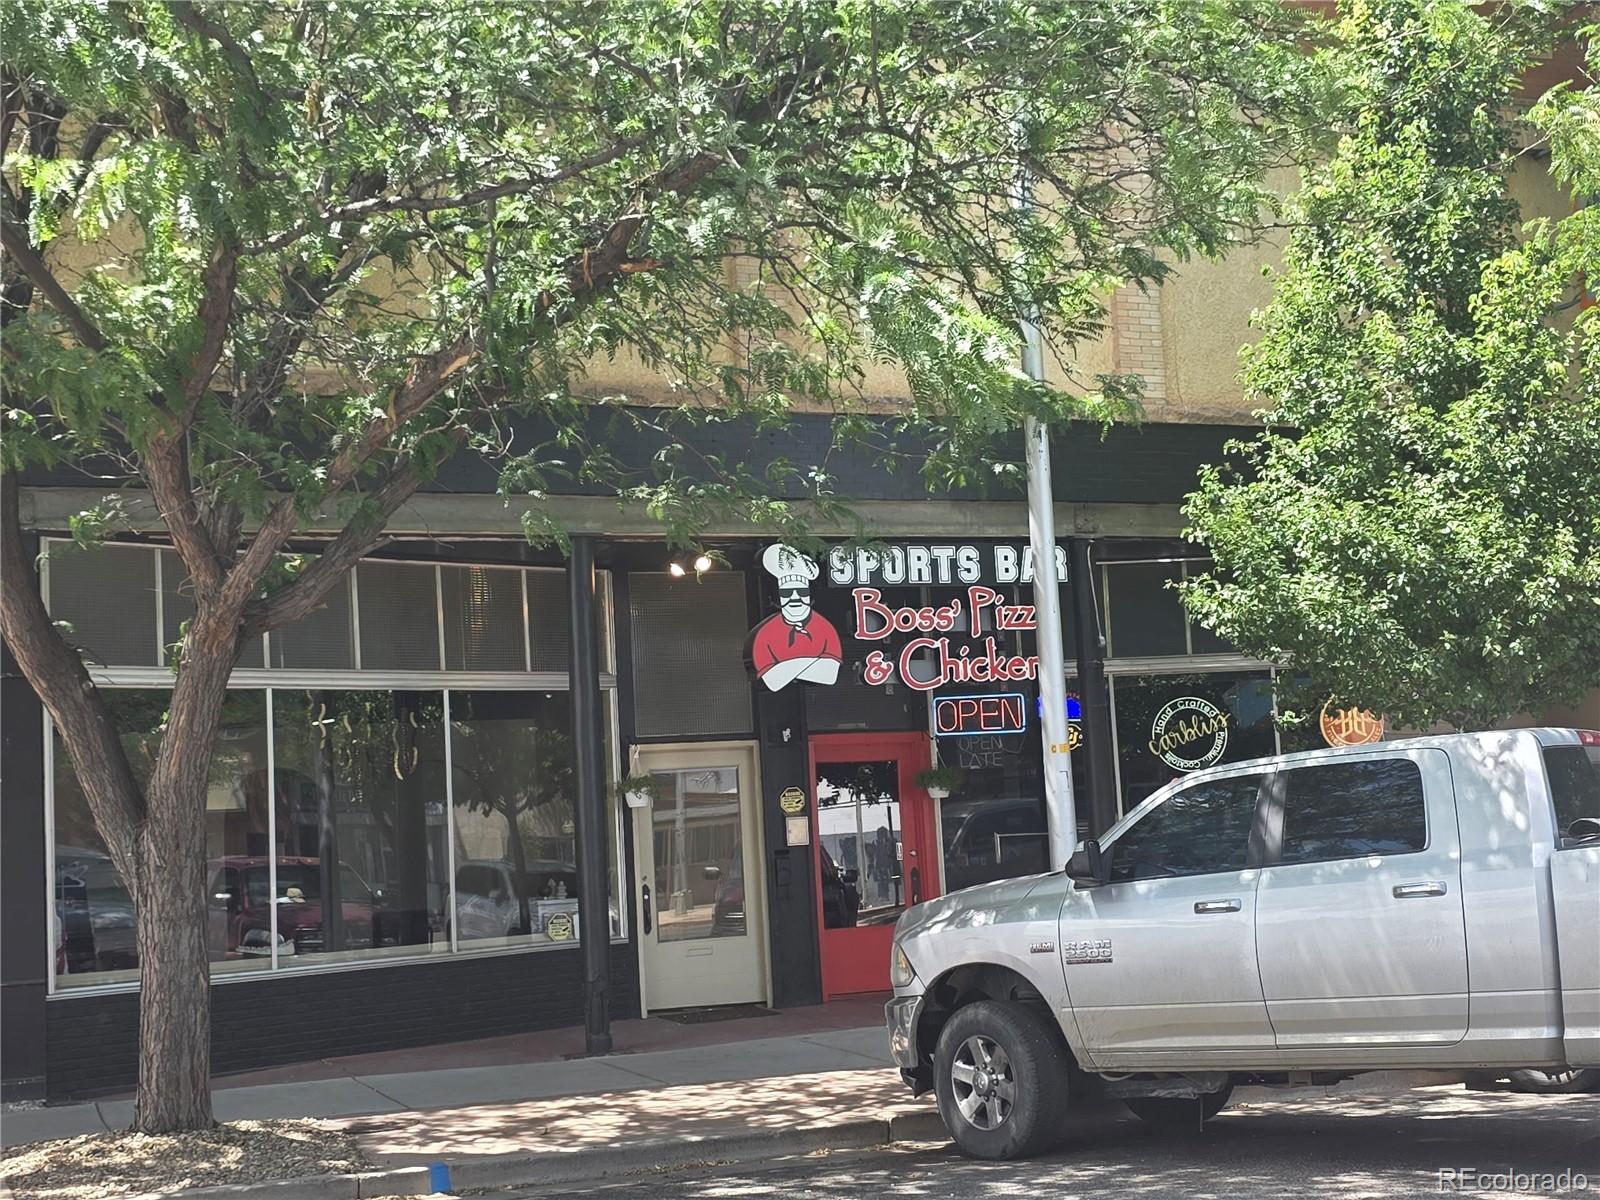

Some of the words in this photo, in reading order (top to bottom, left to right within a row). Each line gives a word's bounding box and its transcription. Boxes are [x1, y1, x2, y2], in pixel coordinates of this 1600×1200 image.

[829, 546, 981, 584] SPORTS
[968, 586, 1037, 637] Pizz
[864, 650, 894, 686] &
[937, 697, 1022, 732] OPEN
[1154, 706, 1173, 734] Hand
[1176, 700, 1217, 717] Crafted
[958, 735, 1003, 750] OPEN
[960, 751, 1004, 769] LATE
[1064, 939, 1112, 950] RAM
[1064, 949, 1113, 959] 2500
